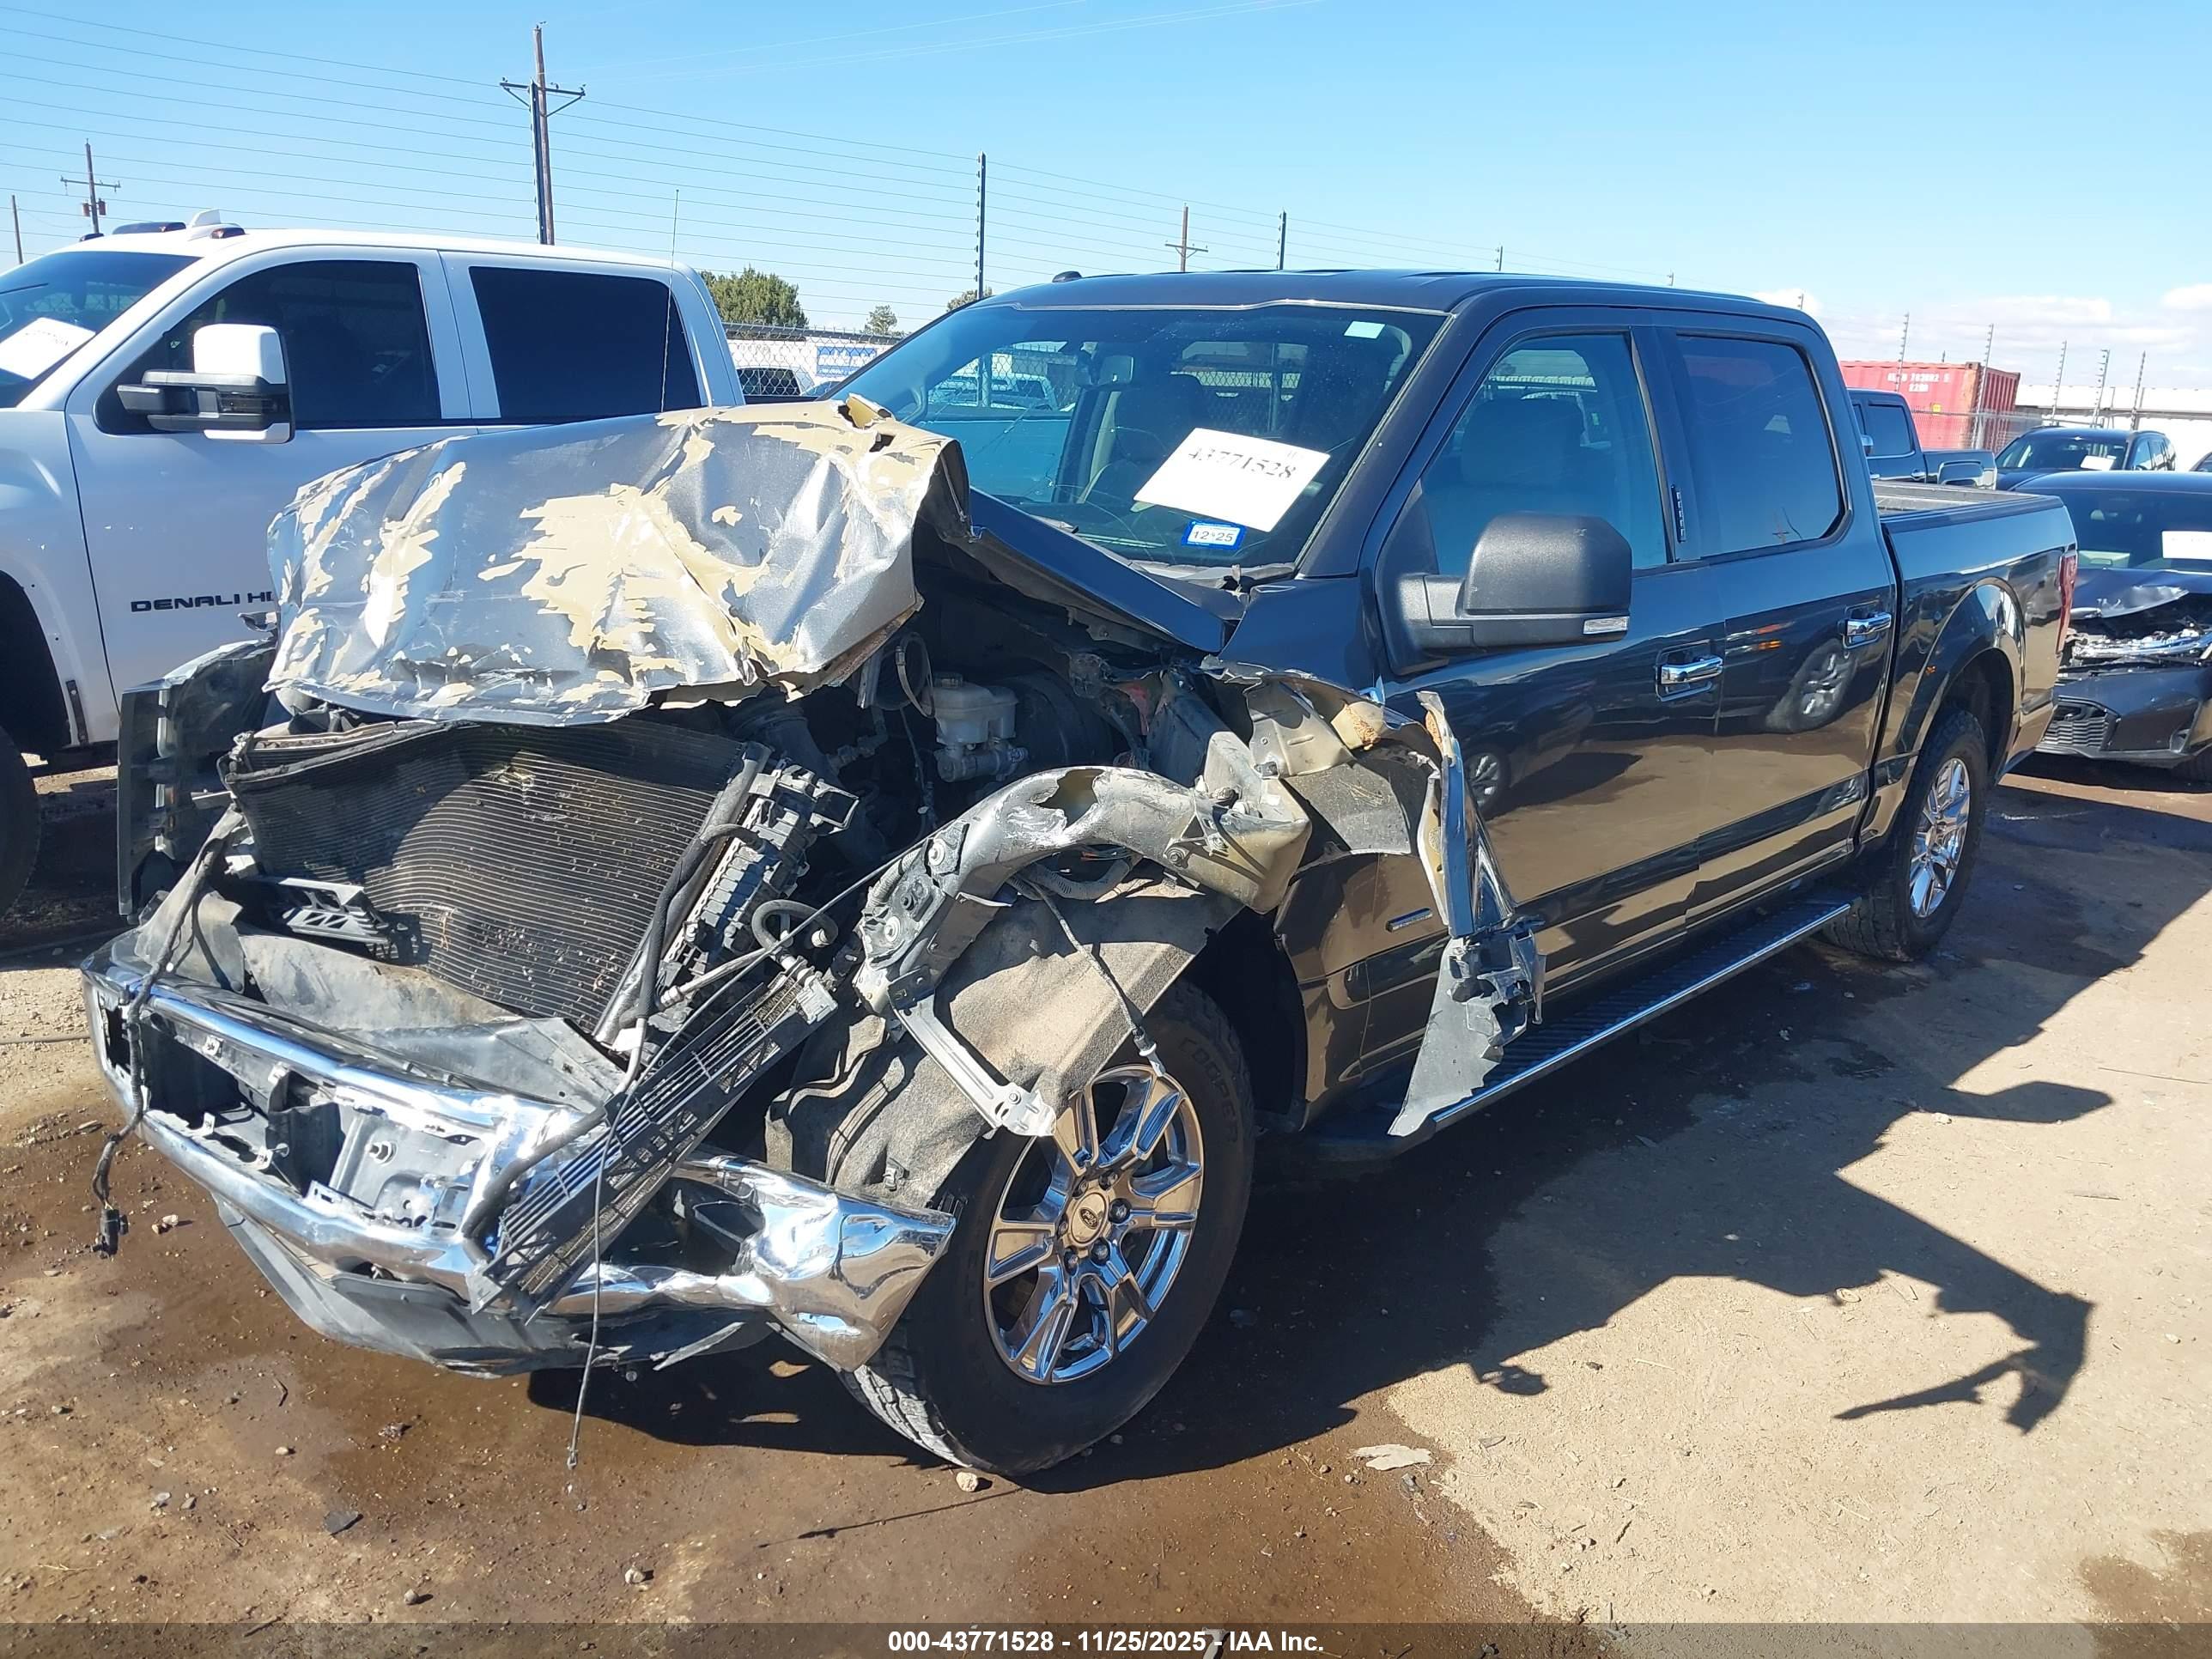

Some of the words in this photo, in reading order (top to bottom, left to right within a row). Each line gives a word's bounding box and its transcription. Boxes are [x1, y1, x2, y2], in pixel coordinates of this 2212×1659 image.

[1188, 446, 1297, 480] 43771528
[1194, 531, 1210, 540] 12
[1215, 532, 1235, 542] 25
[131, 593, 240, 612] DENALI
